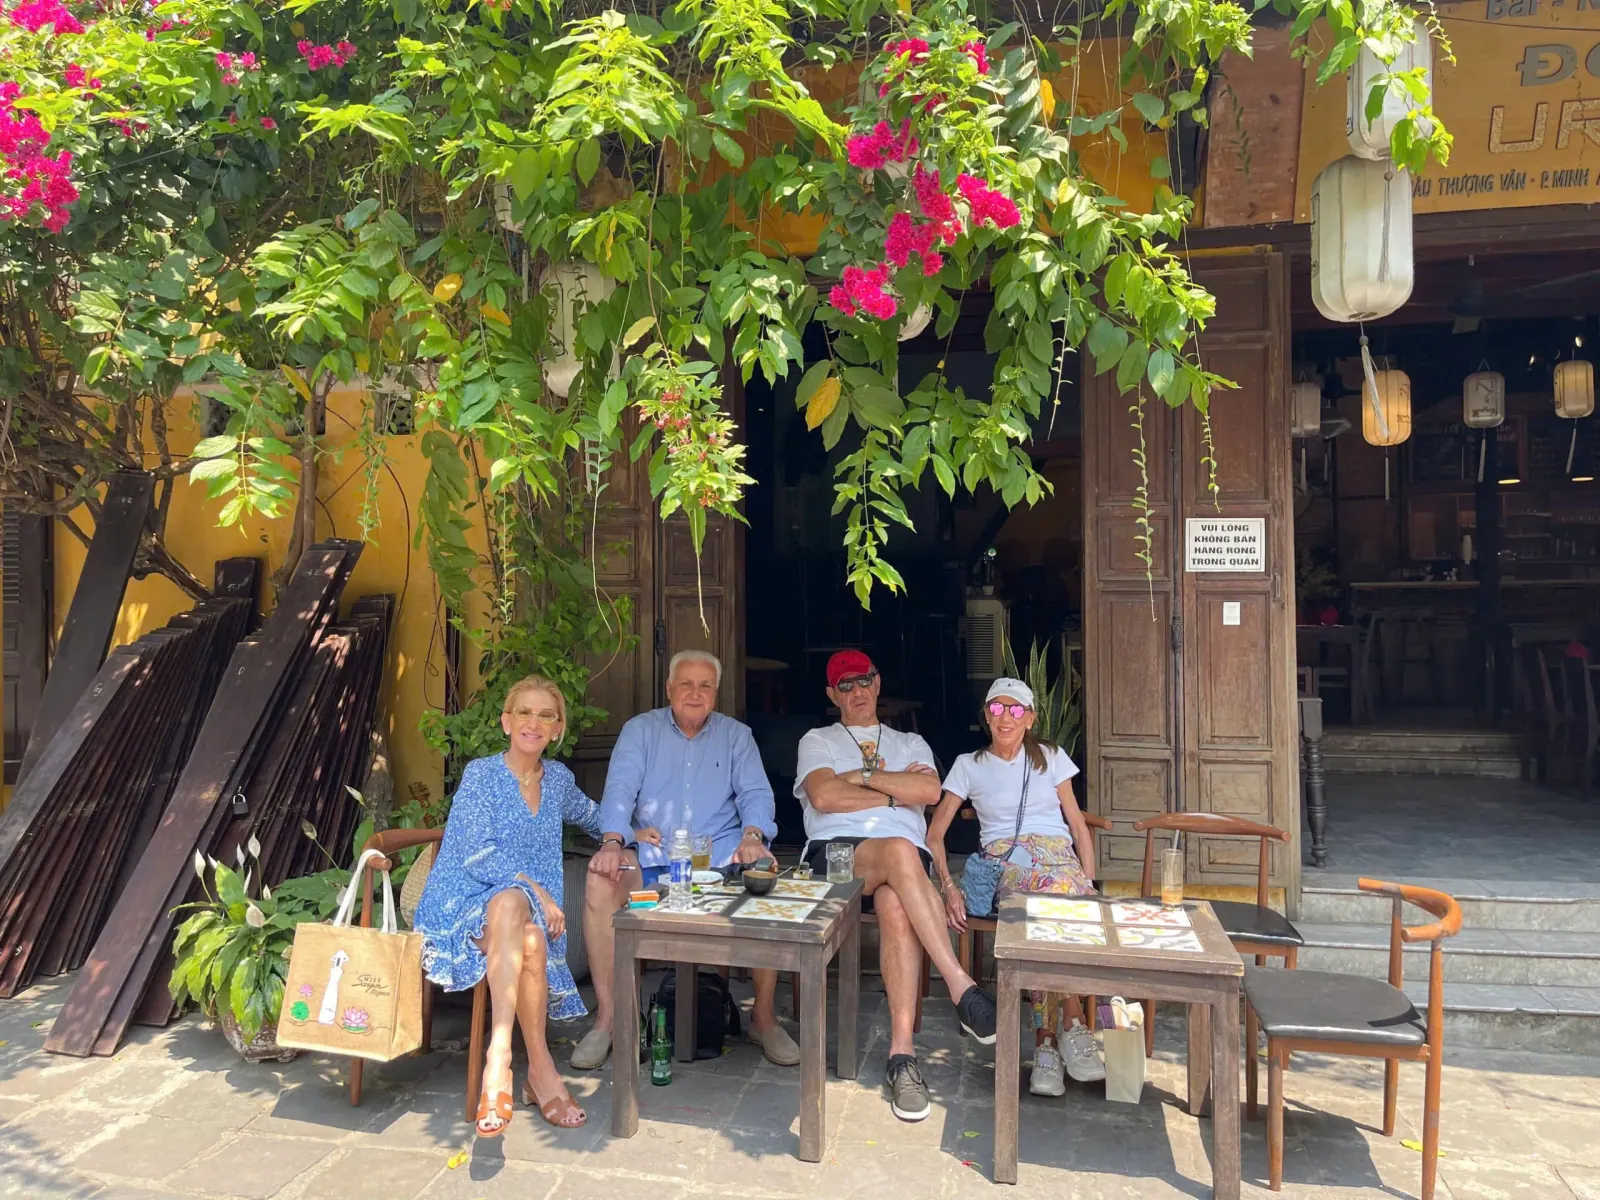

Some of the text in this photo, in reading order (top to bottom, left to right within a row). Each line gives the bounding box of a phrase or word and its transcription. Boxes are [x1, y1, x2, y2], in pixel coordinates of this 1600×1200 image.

[1516, 44, 1600, 87] Đ
[1201, 524, 1218, 532] VUI
[1194, 534, 1230, 543] KHÔNG
[1192, 558, 1226, 566] TRONG
